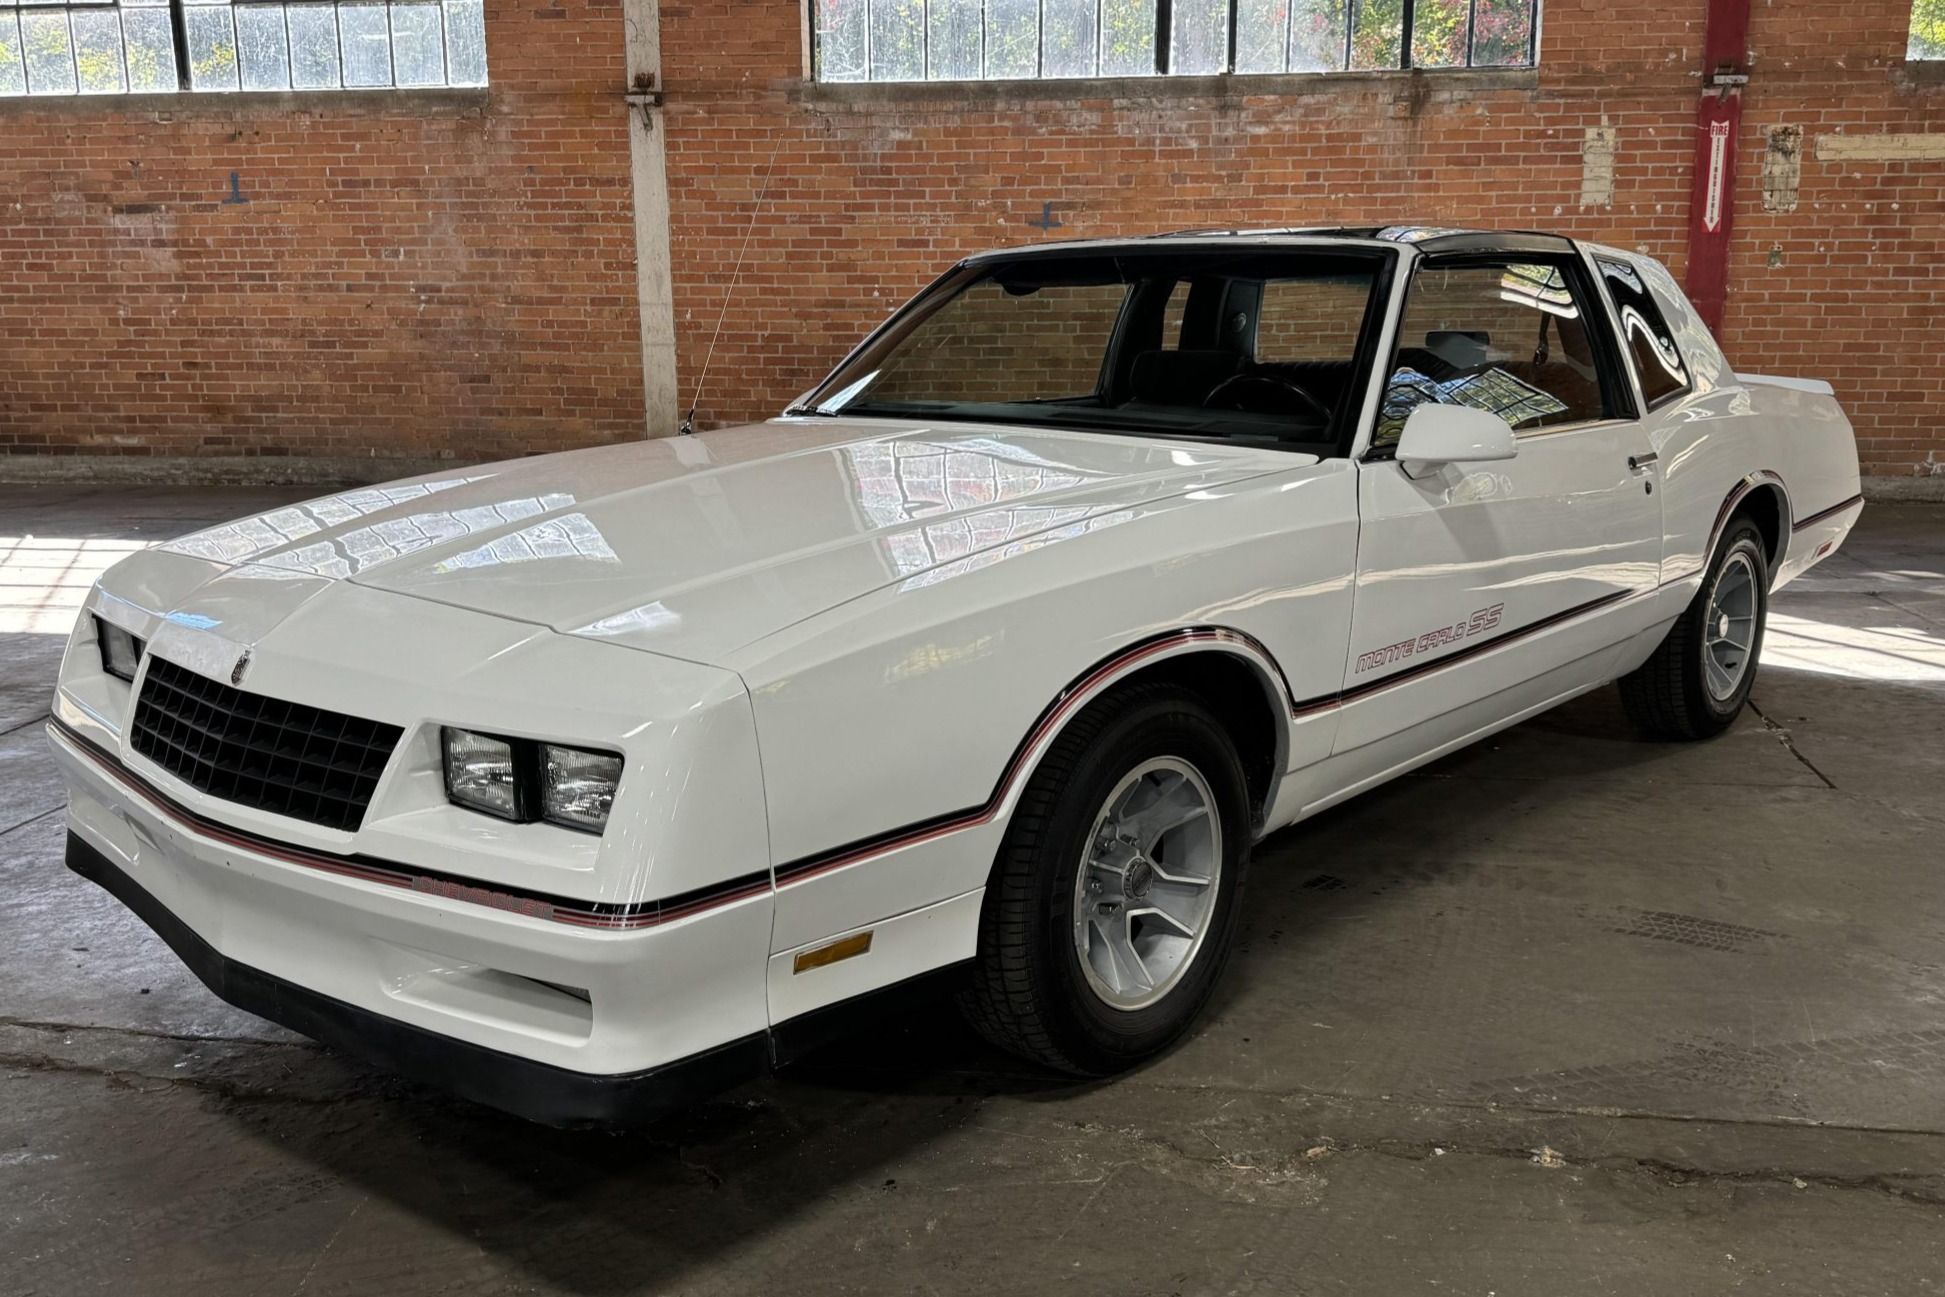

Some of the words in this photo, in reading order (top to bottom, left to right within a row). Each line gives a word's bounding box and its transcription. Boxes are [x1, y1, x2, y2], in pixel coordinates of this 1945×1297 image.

[1711, 125, 1728, 136] FIRE
[1355, 638, 1416, 674] MONTE
[1416, 621, 1467, 653] CARLO
[1466, 602, 1504, 637] SS
[417, 876, 552, 919] CHEVROLET
